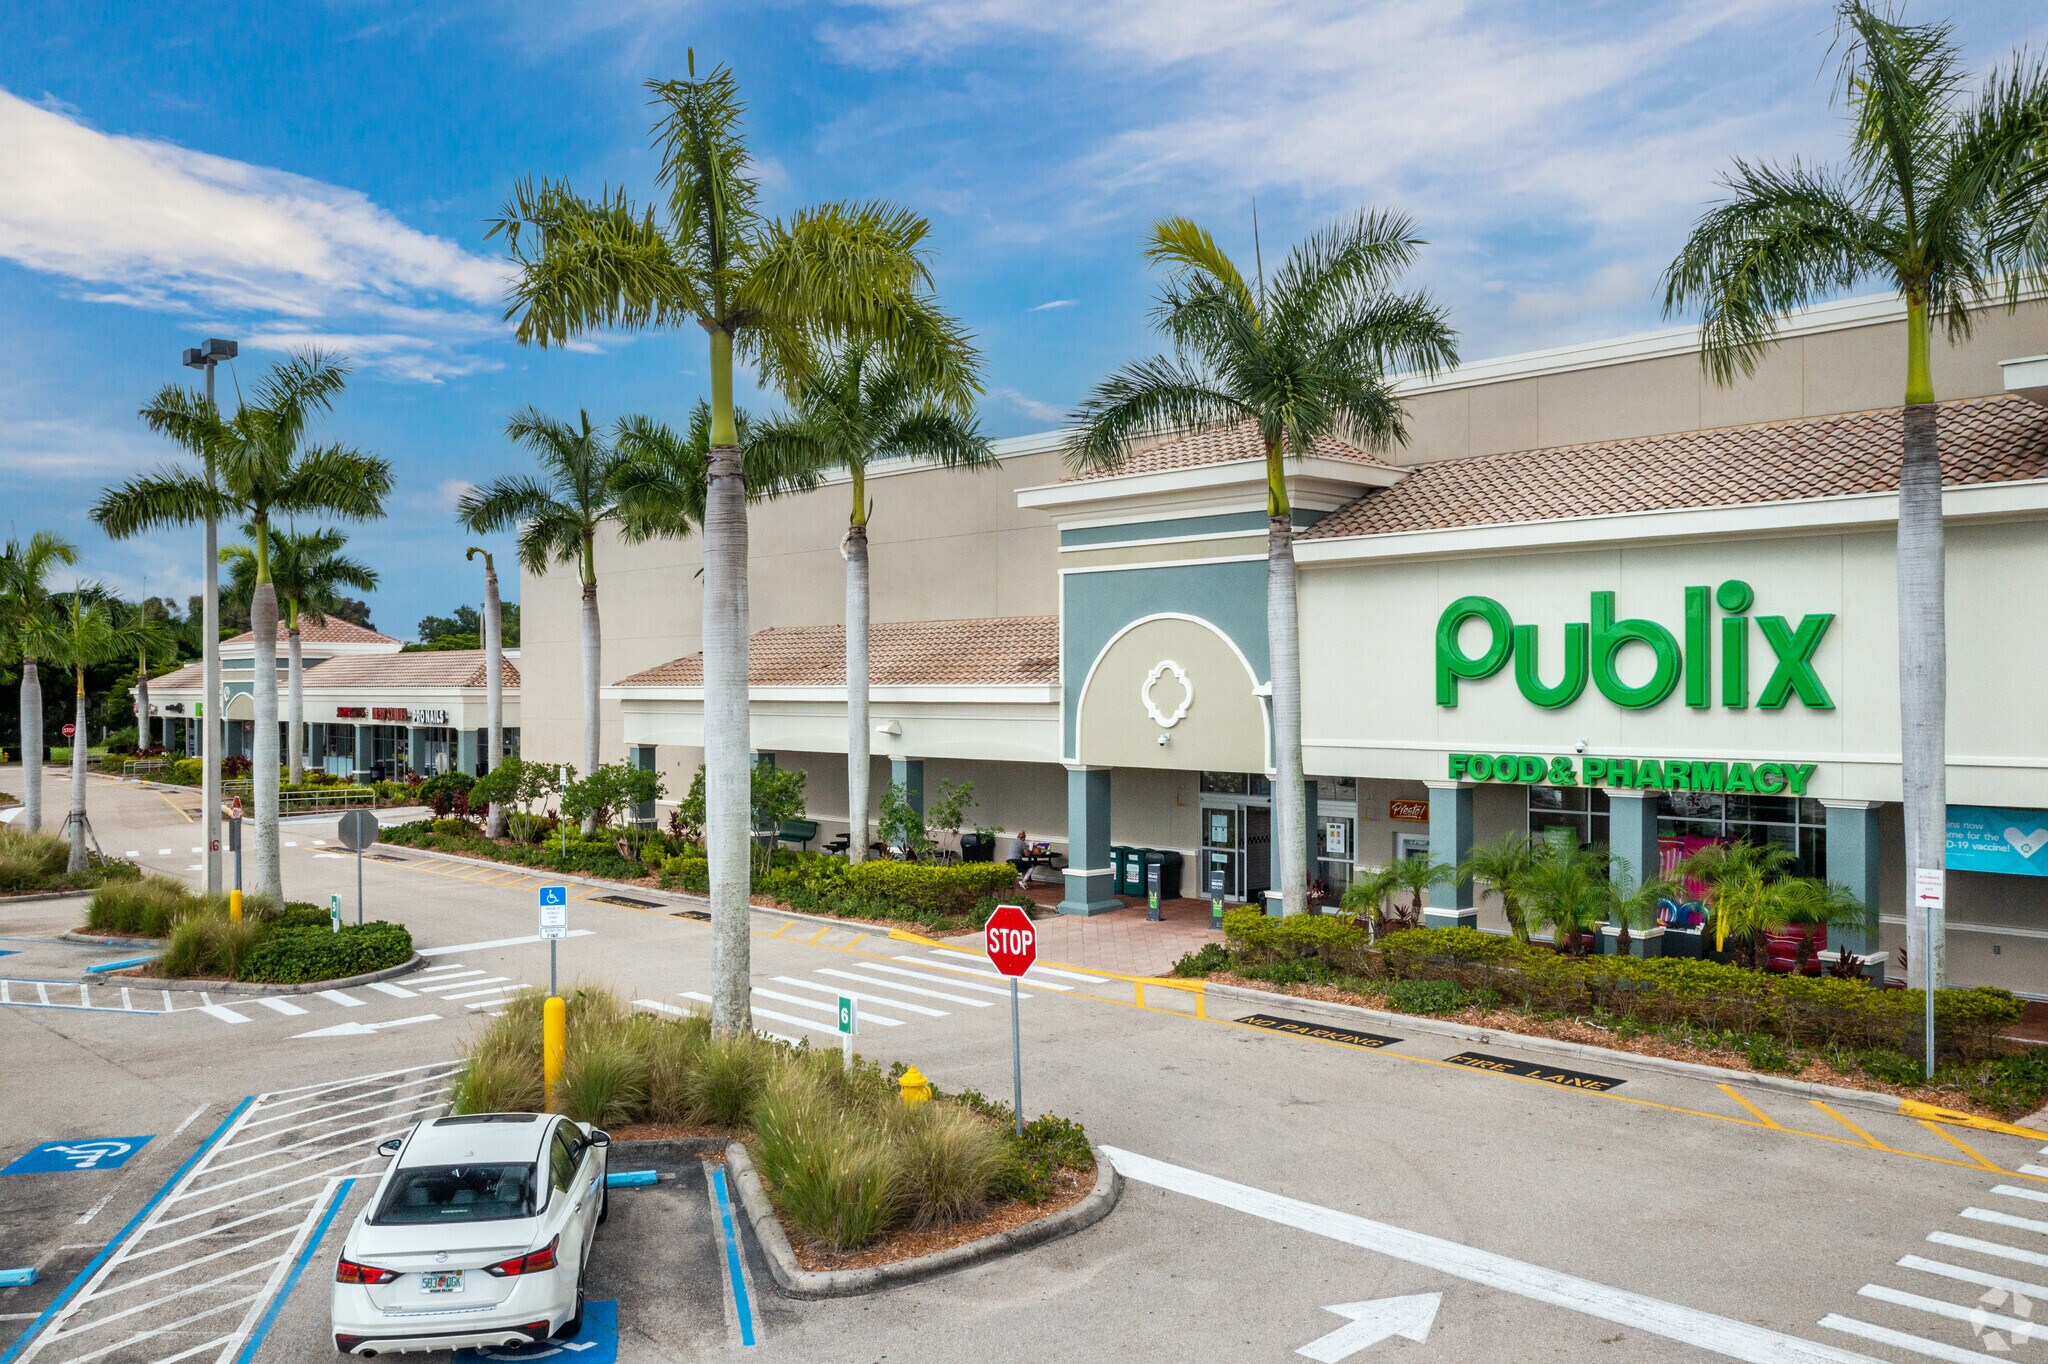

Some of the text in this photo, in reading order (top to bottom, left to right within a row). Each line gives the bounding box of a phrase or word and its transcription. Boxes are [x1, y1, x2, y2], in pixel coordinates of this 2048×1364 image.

[1436, 579, 1836, 710] Publix
[1448, 753, 1547, 783] FOOD
[1582, 757, 1818, 795] PHARMACY
[1391, 802, 1426, 819] Presto!
[1946, 840, 2010, 852] D-19 vaccine!
[1967, 831, 1980, 840] for
[1984, 833, 1999, 841] the
[332, 901, 337, 912] 5
[989, 928, 1033, 956] STOP
[841, 1007, 849, 1024] 6
[1239, 1016, 1384, 1047] NO PARKING
[1449, 1055, 1611, 1090] FIRE LANE
